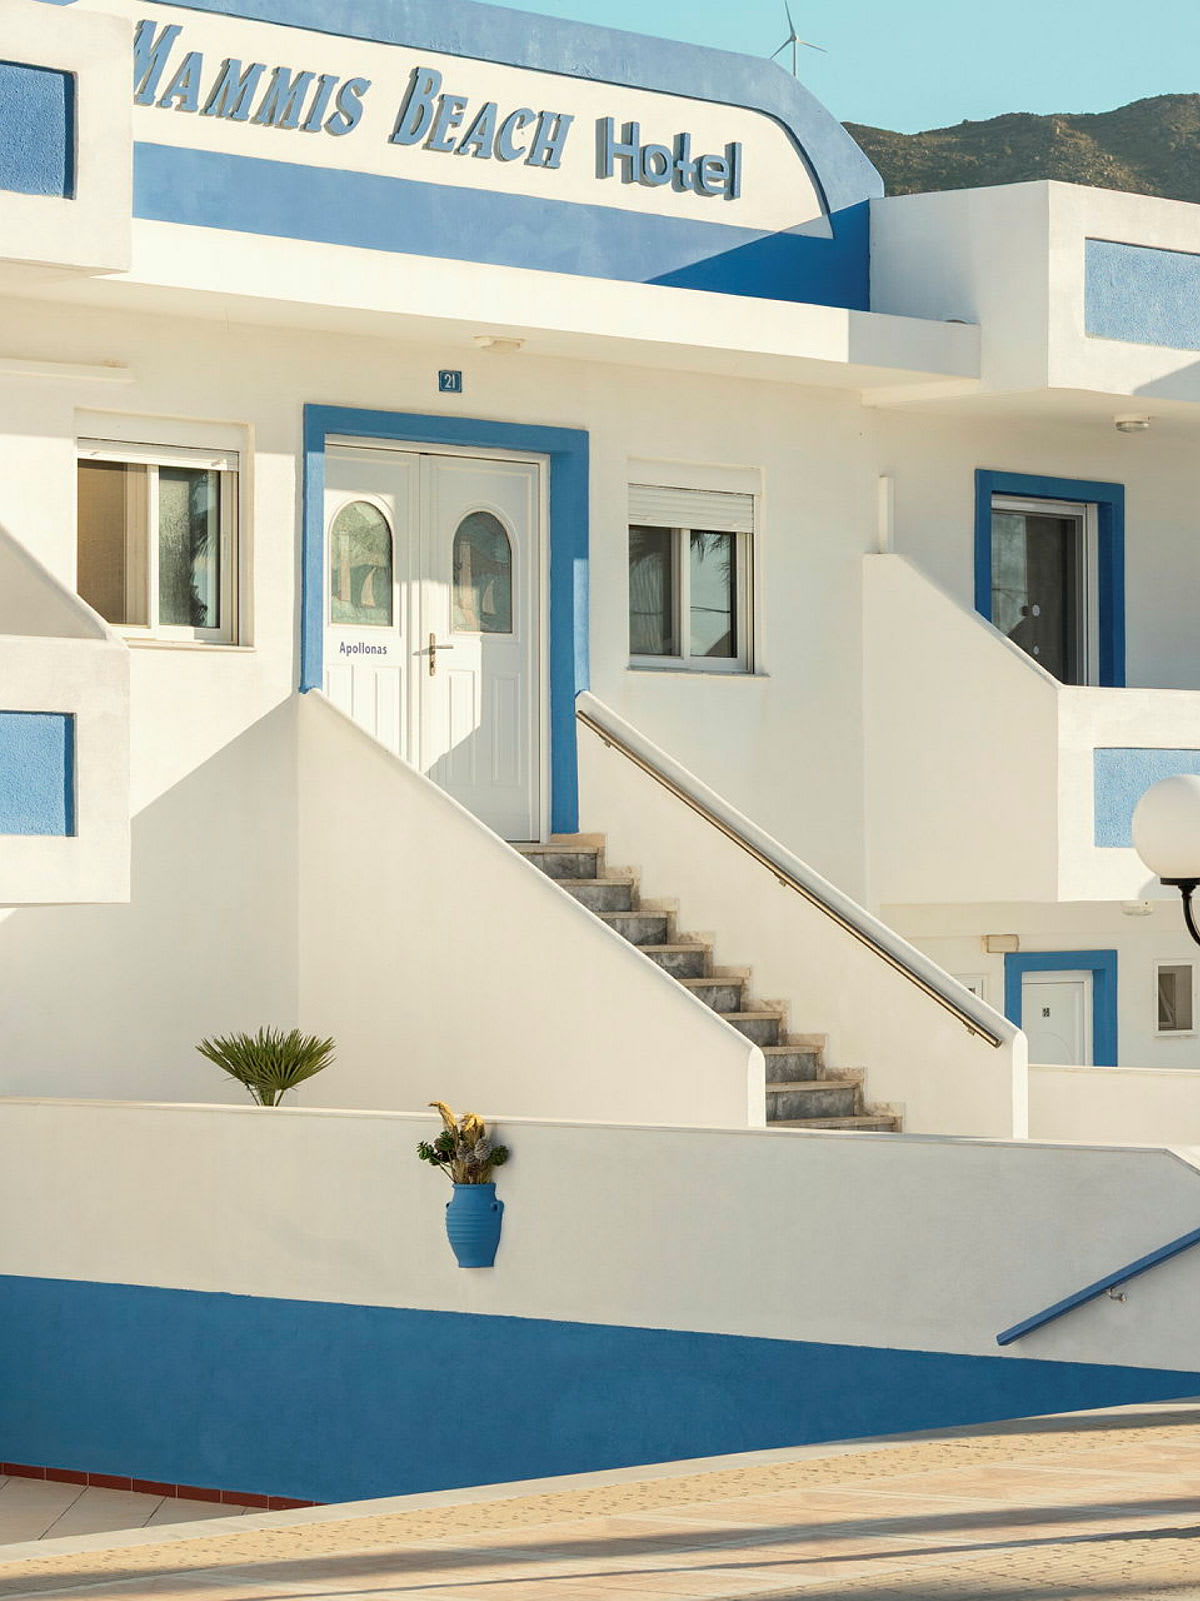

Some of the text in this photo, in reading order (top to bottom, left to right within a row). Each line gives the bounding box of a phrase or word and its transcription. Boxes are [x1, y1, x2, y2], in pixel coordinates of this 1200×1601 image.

[134, 19, 742, 201] MAMMIS BEACH Hotel
[444, 373, 456, 389] 21
[339, 641, 388, 657] Apollonas
